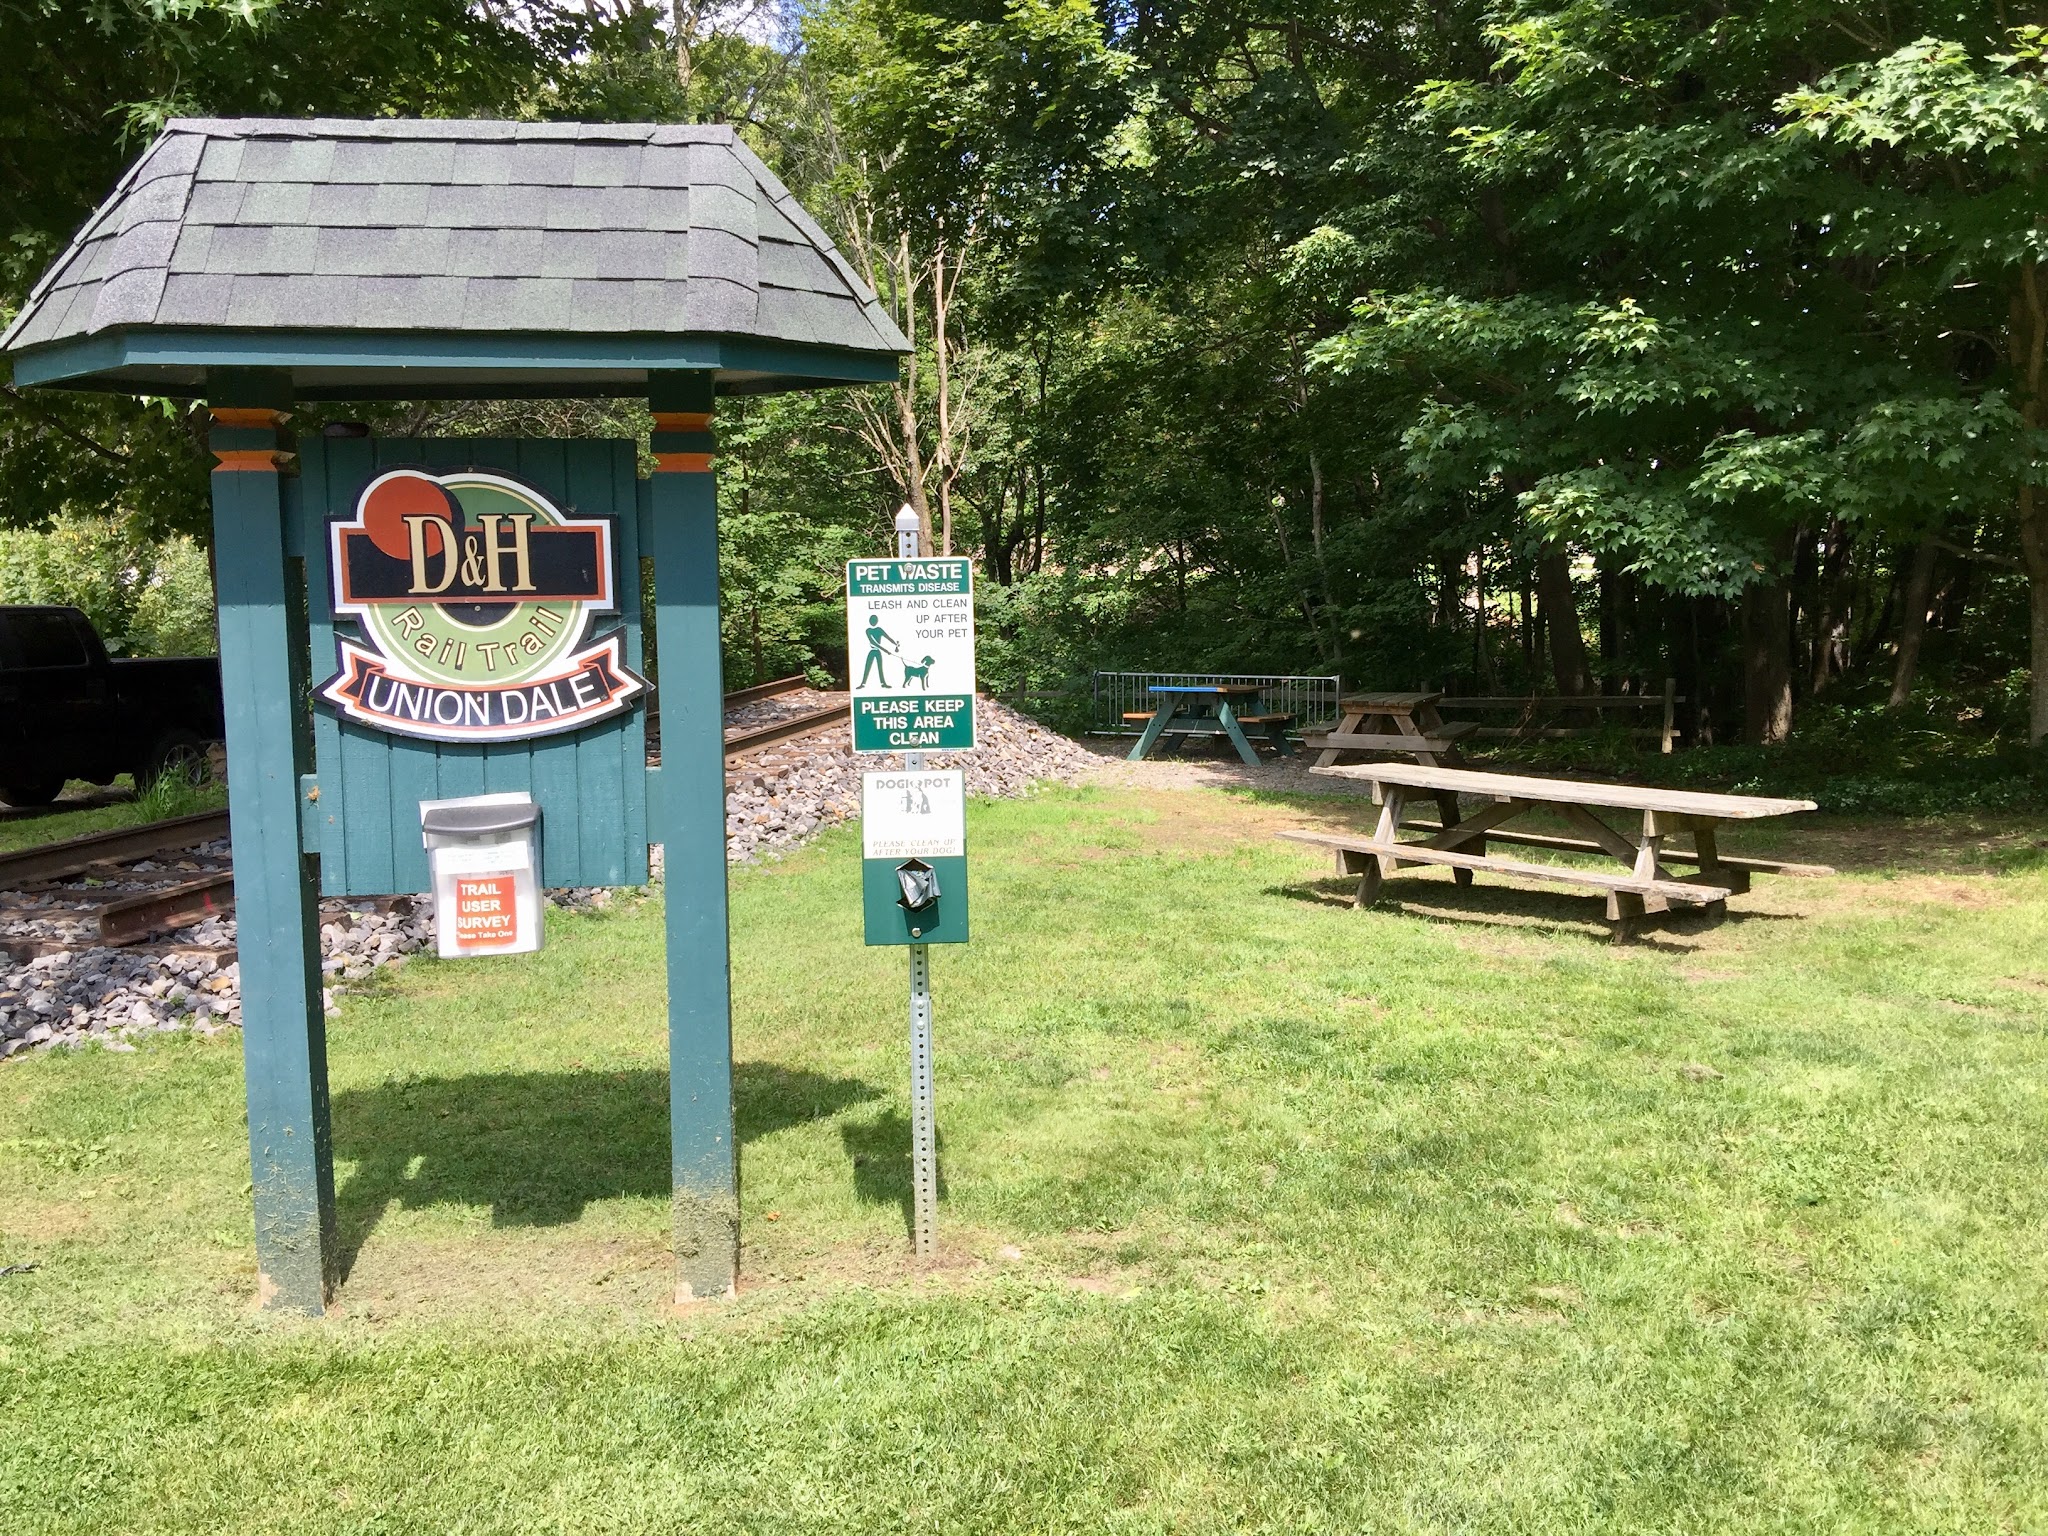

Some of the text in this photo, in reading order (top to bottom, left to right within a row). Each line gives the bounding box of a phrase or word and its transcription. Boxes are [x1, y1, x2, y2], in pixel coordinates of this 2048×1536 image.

[402, 514, 537, 593] D&H
[856, 563, 962, 581] PET WASTE
[860, 582, 960, 593] TRANSMITS DISEASE
[868, 599, 967, 610] LEASH AND CLEAN
[916, 614, 967, 623] UP AFTER
[392, 606, 564, 671] Rail Trail
[916, 629, 967, 639] YOUR PET
[367, 671, 601, 726] UNION DALE
[861, 699, 964, 714] PLEASE KEEP
[873, 715, 954, 729] THIS AREA
[889, 732, 940, 745] CLEAN
[873, 838, 956, 848] PLEASE CLEAN UP
[873, 846, 956, 856] AFTER YOUR DOG!
[461, 884, 501, 896] TRAIL
[462, 901, 501, 912] USER
[458, 915, 511, 929] SURVEY
[478, 931, 496, 939] Take
[498, 930, 513, 938] One
